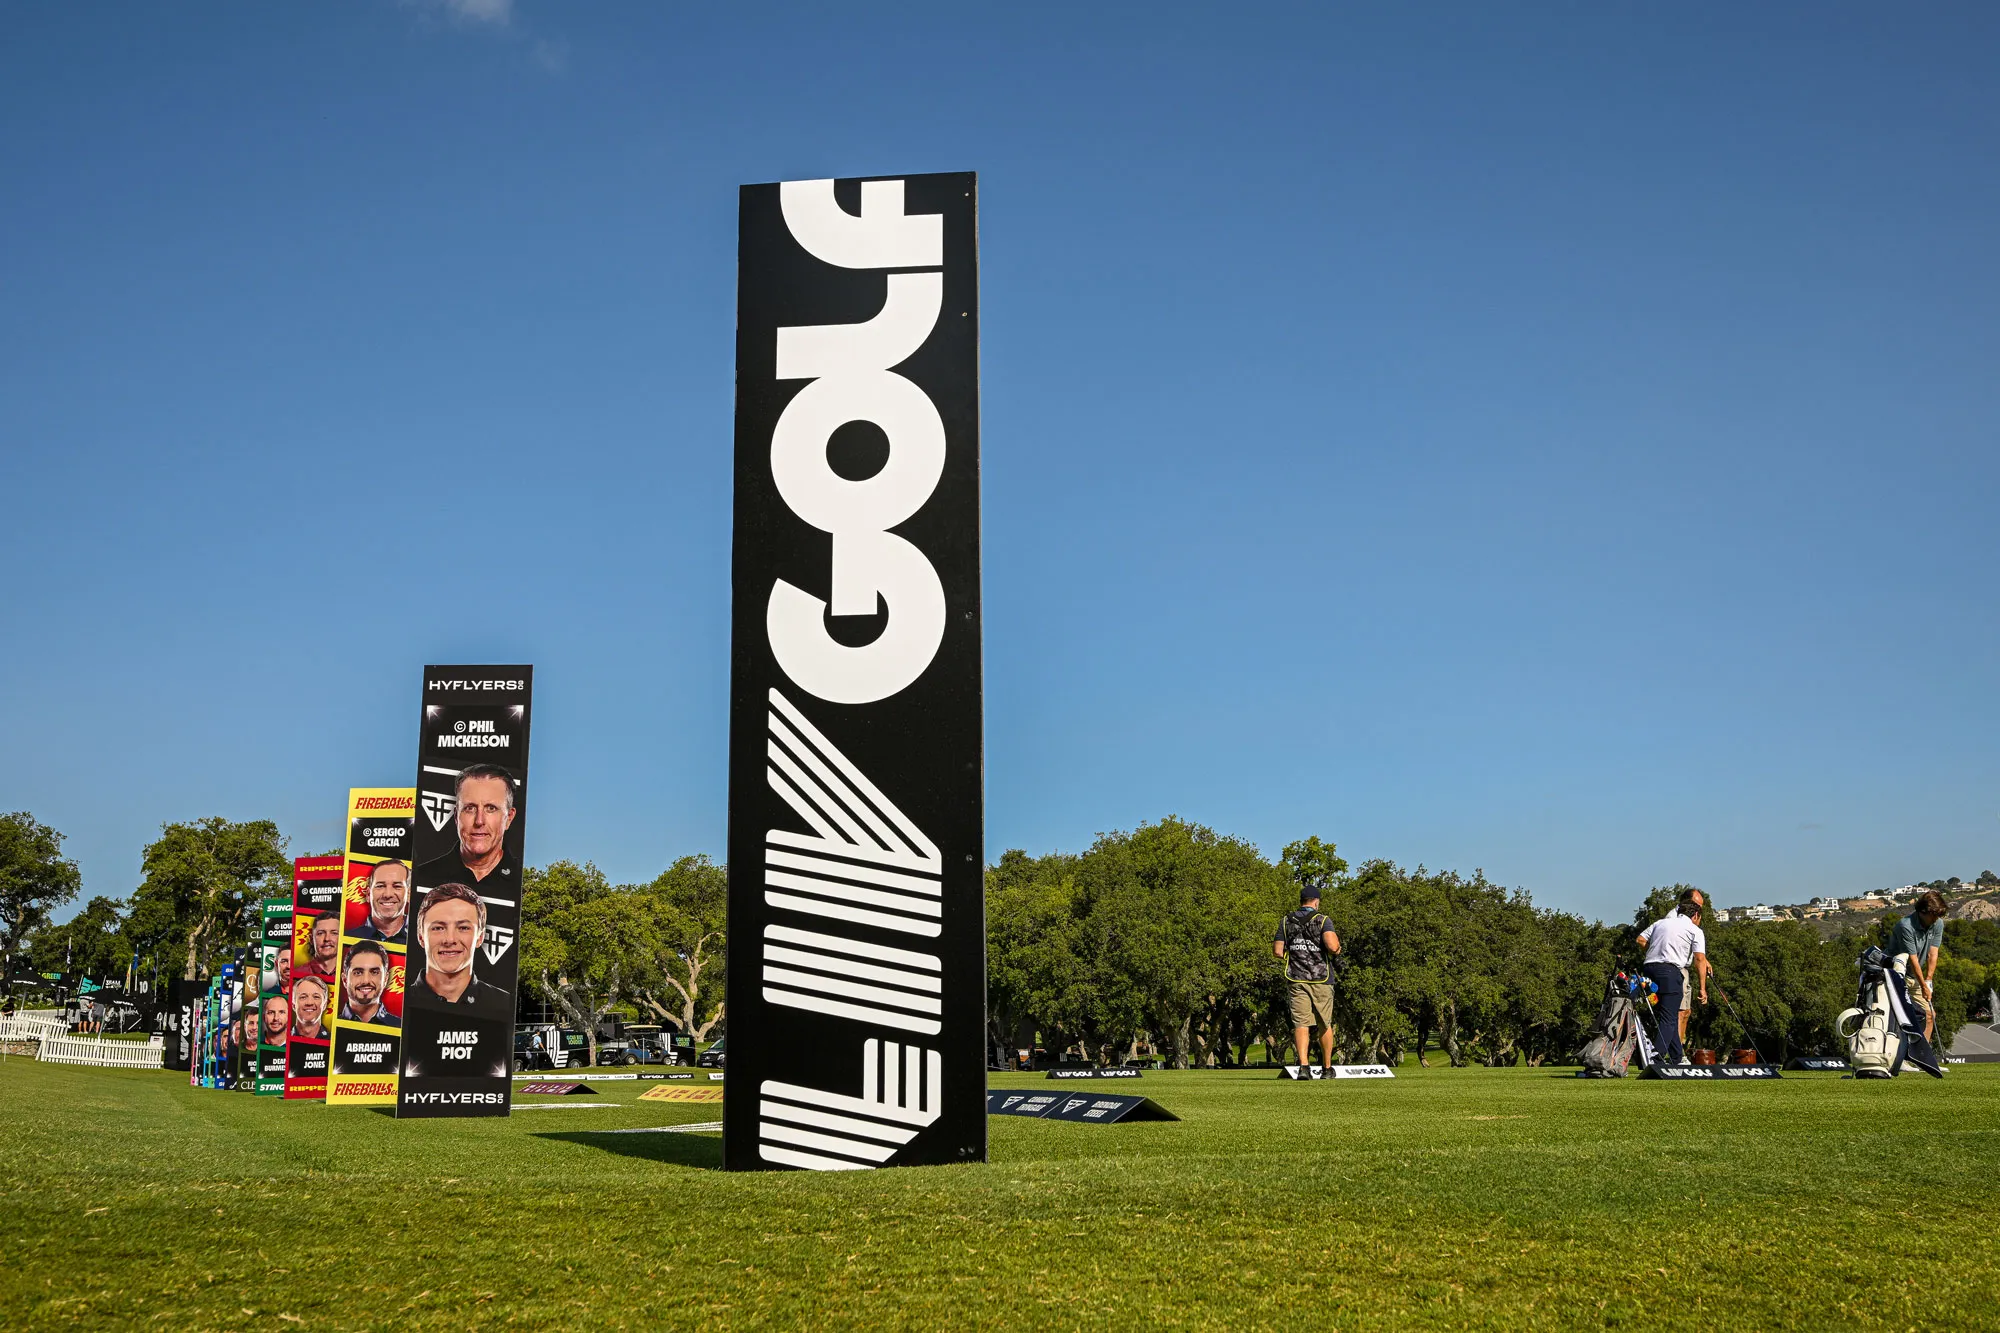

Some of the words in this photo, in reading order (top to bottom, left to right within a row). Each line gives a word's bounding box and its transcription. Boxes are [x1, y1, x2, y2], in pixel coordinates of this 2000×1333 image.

[766, 178, 947, 705] GOLF
[428, 680, 517, 691] HYFLYERS
[468, 720, 495, 733] PHIL
[437, 735, 509, 748] MICKELSON
[355, 796, 412, 810] FIREBALLS
[372, 827, 406, 837] SERGIO
[367, 837, 400, 848] GARCIA
[309, 886, 343, 895] CAMERON
[311, 894, 332, 903] SMITH
[181, 1005, 190, 1036] GOLF
[436, 1031, 479, 1044] JAMES
[345, 1043, 392, 1053] ABRAHAM
[441, 1046, 473, 1060] PIOT
[305, 1052, 325, 1061] MATT
[353, 1053, 383, 1063] ANCER
[303, 1060, 326, 1069] JONES
[1683, 1068, 1713, 1077] GOLF
[1743, 1068, 1772, 1077] GOLF
[333, 1082, 394, 1096] FIREBALLS
[404, 1092, 497, 1104] HYFLYERS
